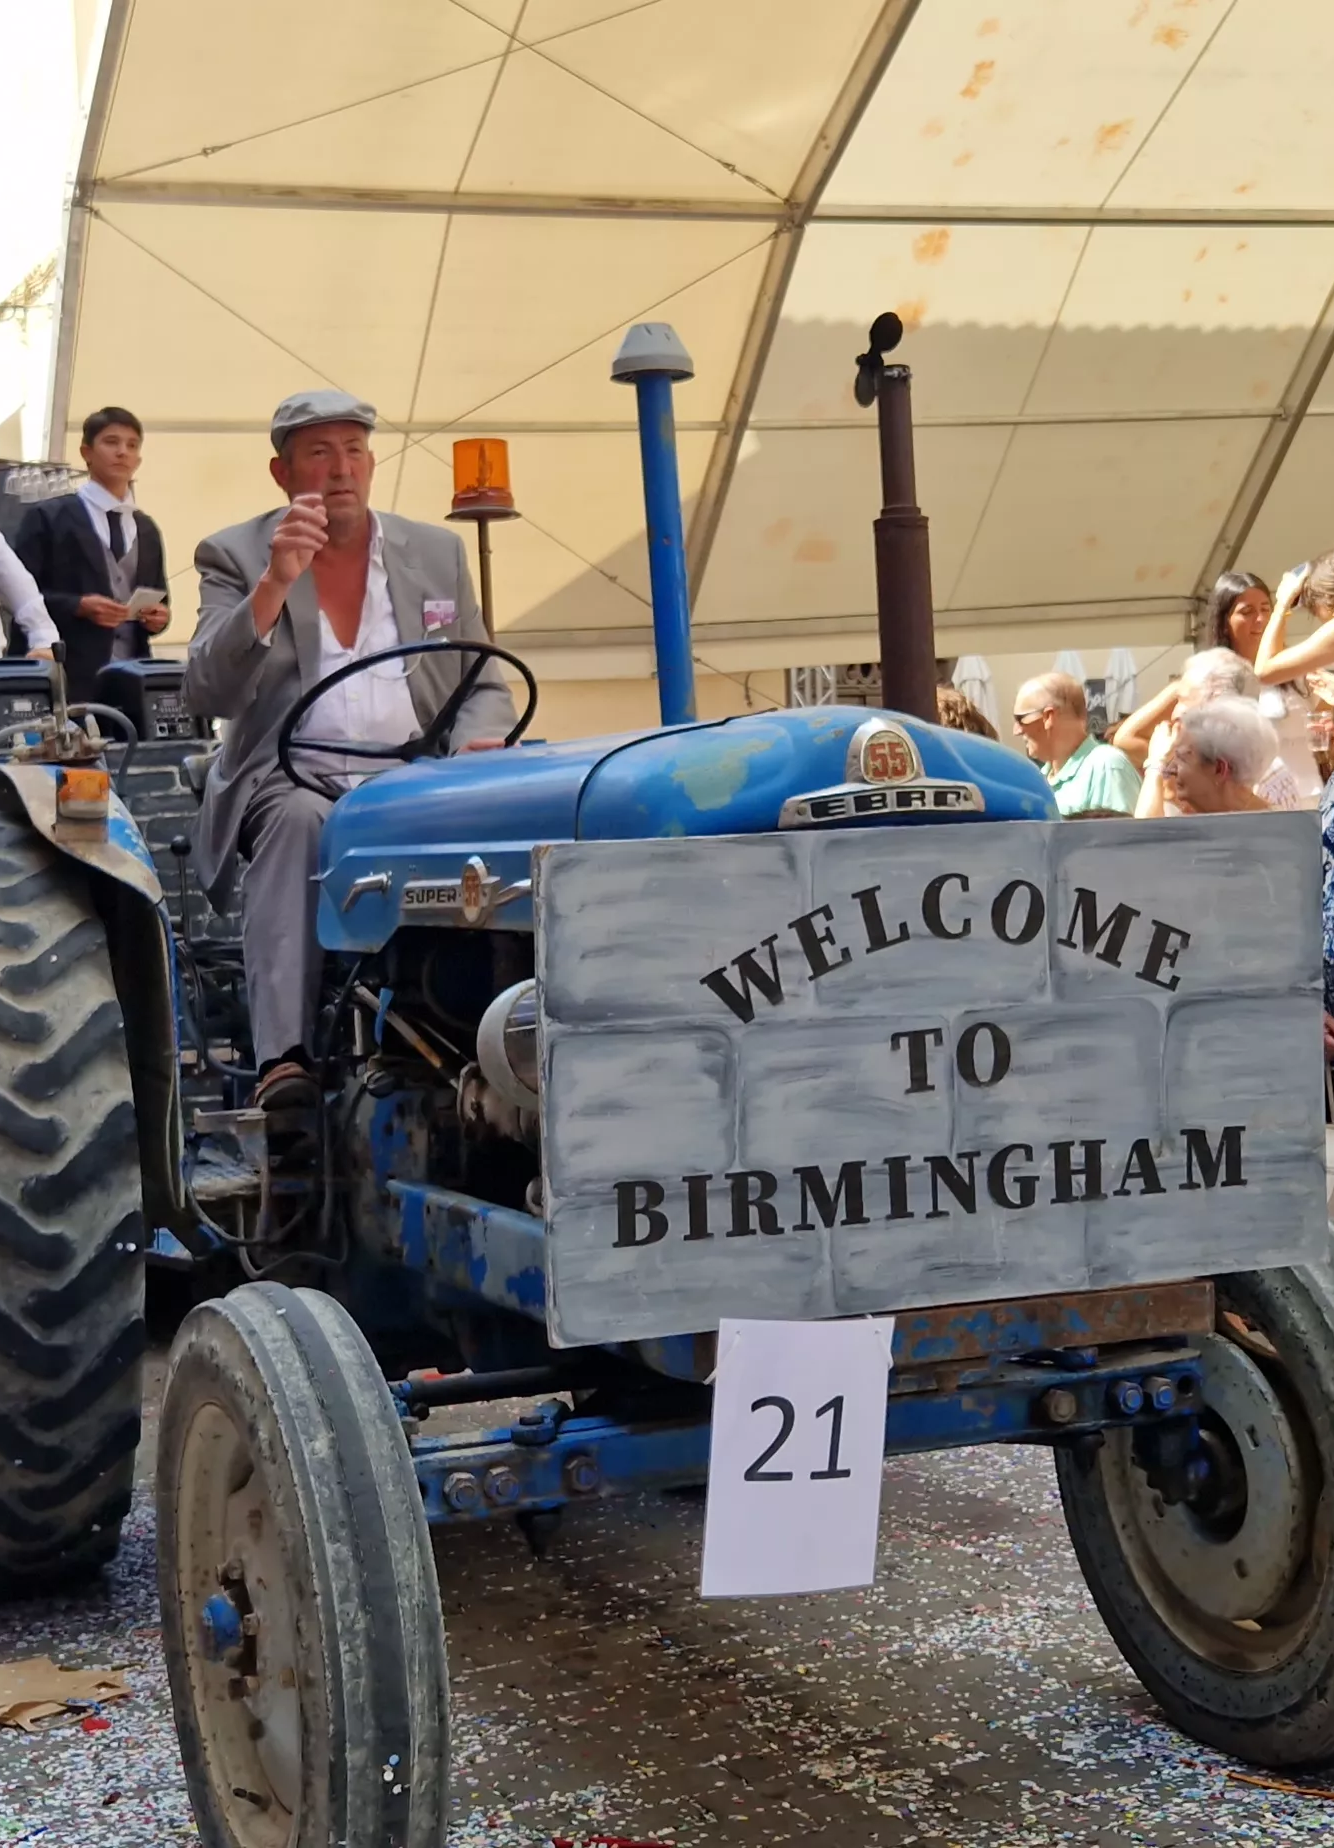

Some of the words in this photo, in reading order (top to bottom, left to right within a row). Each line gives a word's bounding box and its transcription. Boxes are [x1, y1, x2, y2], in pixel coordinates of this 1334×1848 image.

[869, 742, 908, 780] 55
[405, 887, 457, 905] SUPER
[700, 873, 1191, 1024] WELCOME
[890, 1021, 1012, 1094] TO
[612, 1125, 1248, 1249] BIRMINGHAM
[743, 1395, 851, 1482] 21
